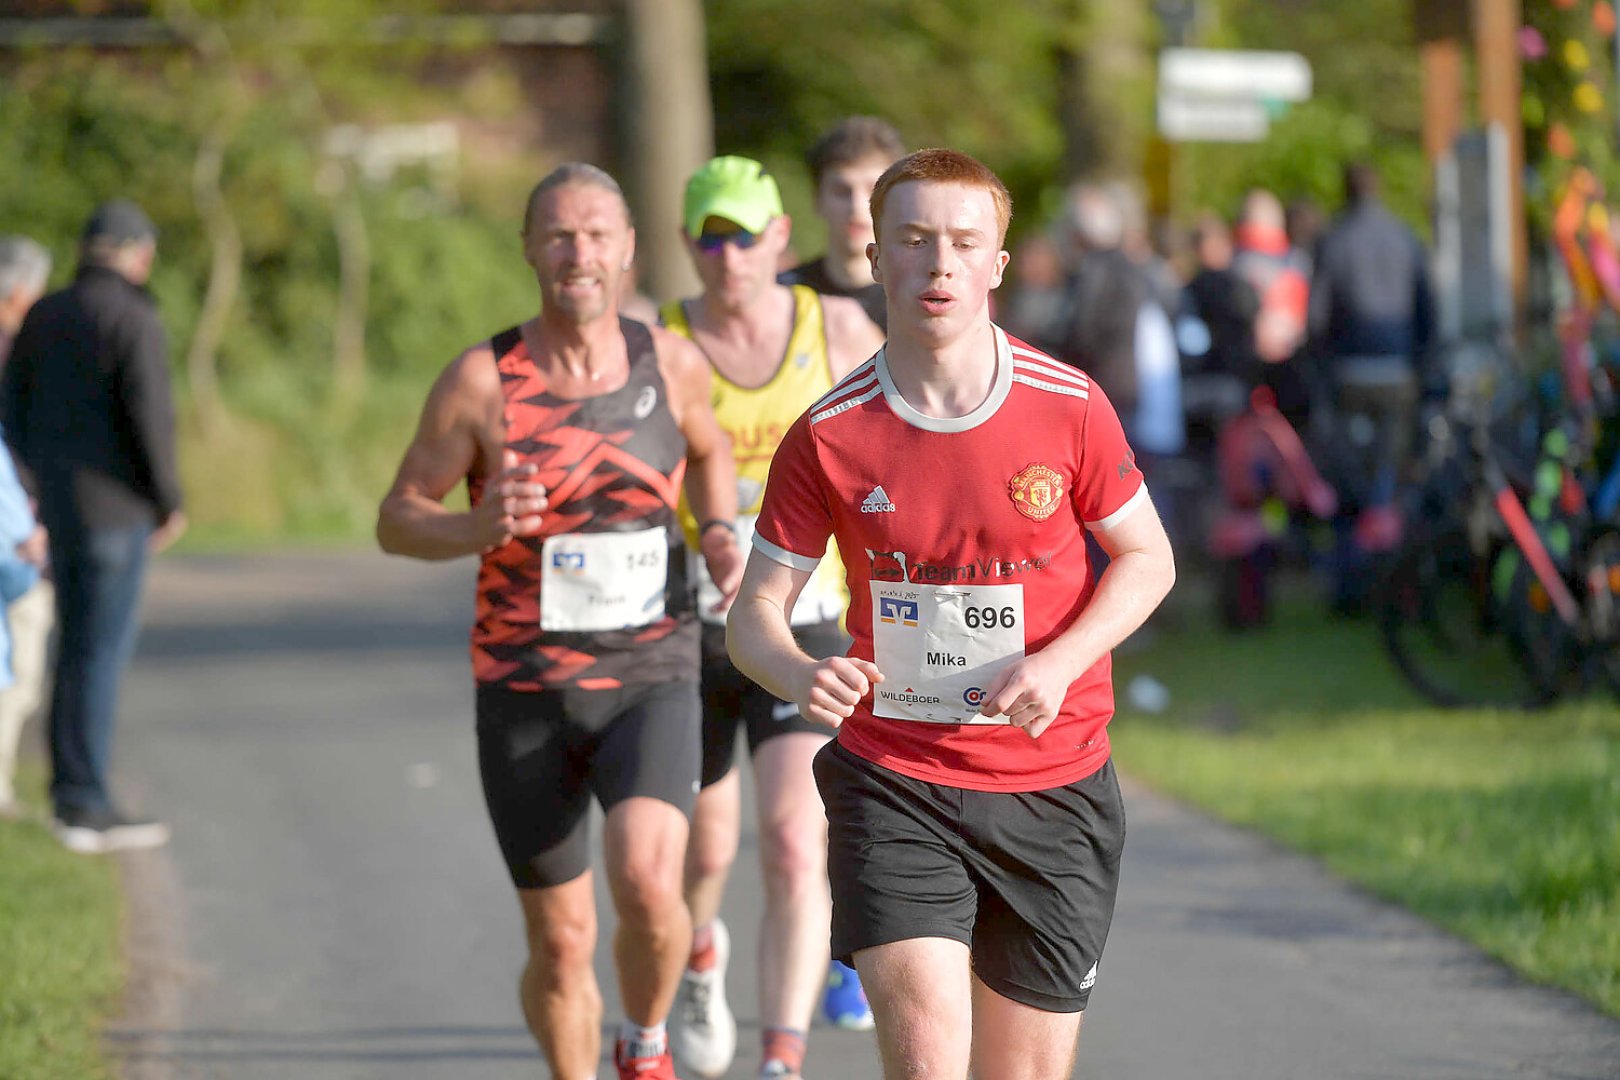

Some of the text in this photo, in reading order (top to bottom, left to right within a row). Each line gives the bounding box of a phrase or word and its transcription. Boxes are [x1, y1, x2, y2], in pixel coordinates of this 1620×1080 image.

[861, 502, 896, 513] adidas
[964, 606, 1016, 629] 696
[926, 651, 967, 667] Mika
[880, 690, 940, 704] WILDEBOER
